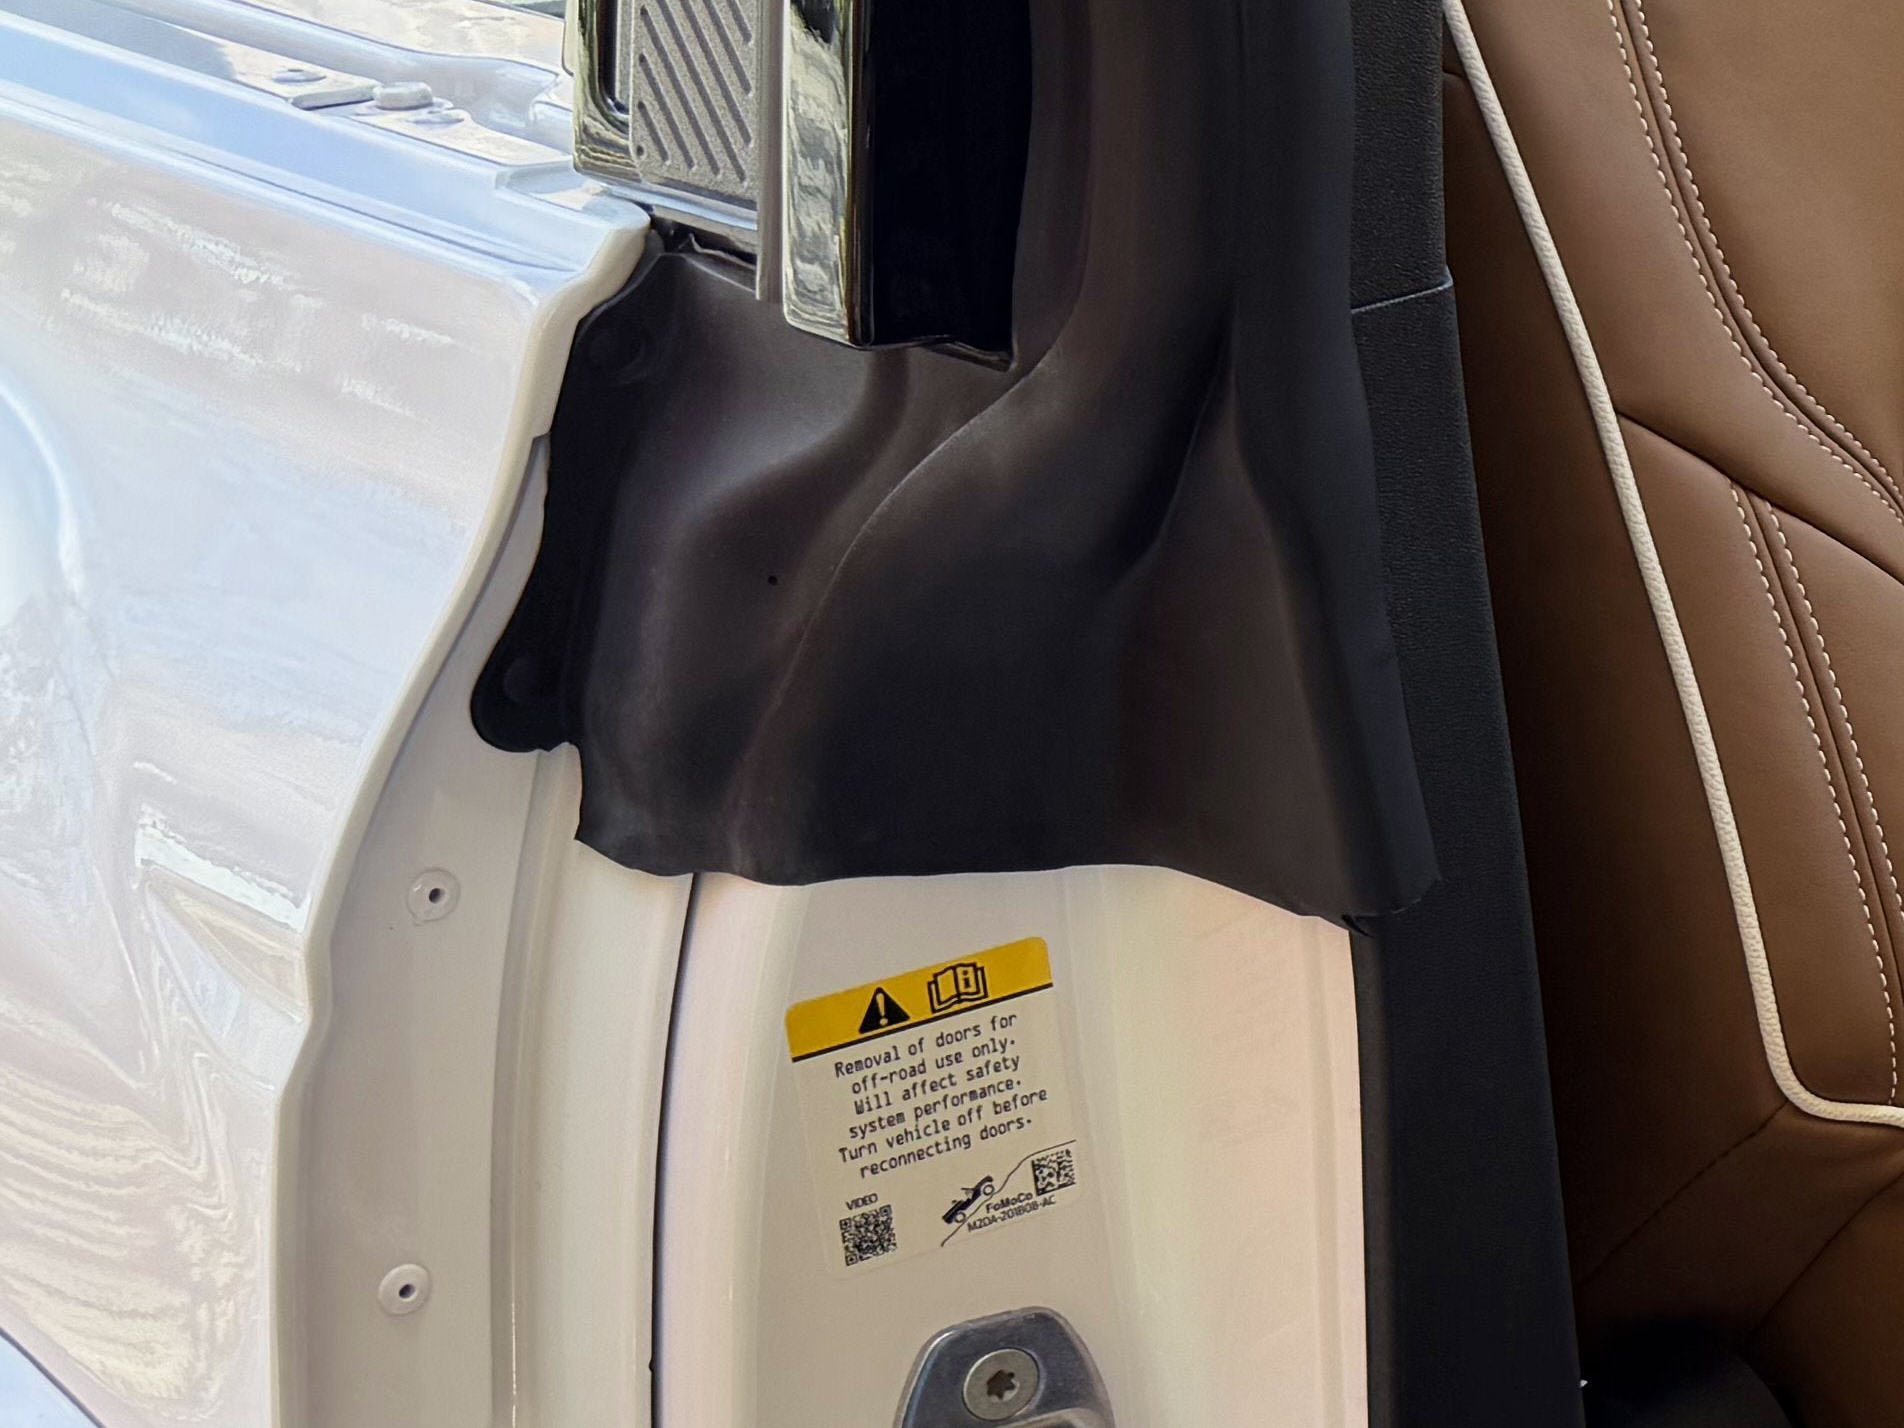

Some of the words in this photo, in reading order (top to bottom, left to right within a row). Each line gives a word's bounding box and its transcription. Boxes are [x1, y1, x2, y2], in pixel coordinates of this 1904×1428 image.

[834, 1045, 901, 1079] Removal
[908, 1037, 925, 1056] of
[935, 1024, 982, 1048] doors
[990, 1014, 1017, 1032] for
[852, 1058, 927, 1094] off-road
[935, 1050, 963, 1070] use
[972, 1037, 1016, 1059] only.
[849, 1111, 906, 1140] system
[914, 1079, 1022, 1122] performance.
[854, 1091, 892, 1116] Will
[902, 1073, 958, 1102] affect
[966, 1055, 1020, 1082] safety
[838, 1141, 878, 1163] Turn
[886, 1119, 951, 1149] vehicle
[957, 1104, 983, 1127] off
[993, 1088, 1048, 1116] before
[860, 1133, 972, 1179] reconnecting
[980, 1116, 1032, 1141] doors.
[845, 1192, 878, 1211] VIDEO
[985, 1192, 1034, 1214] FoMoCo
